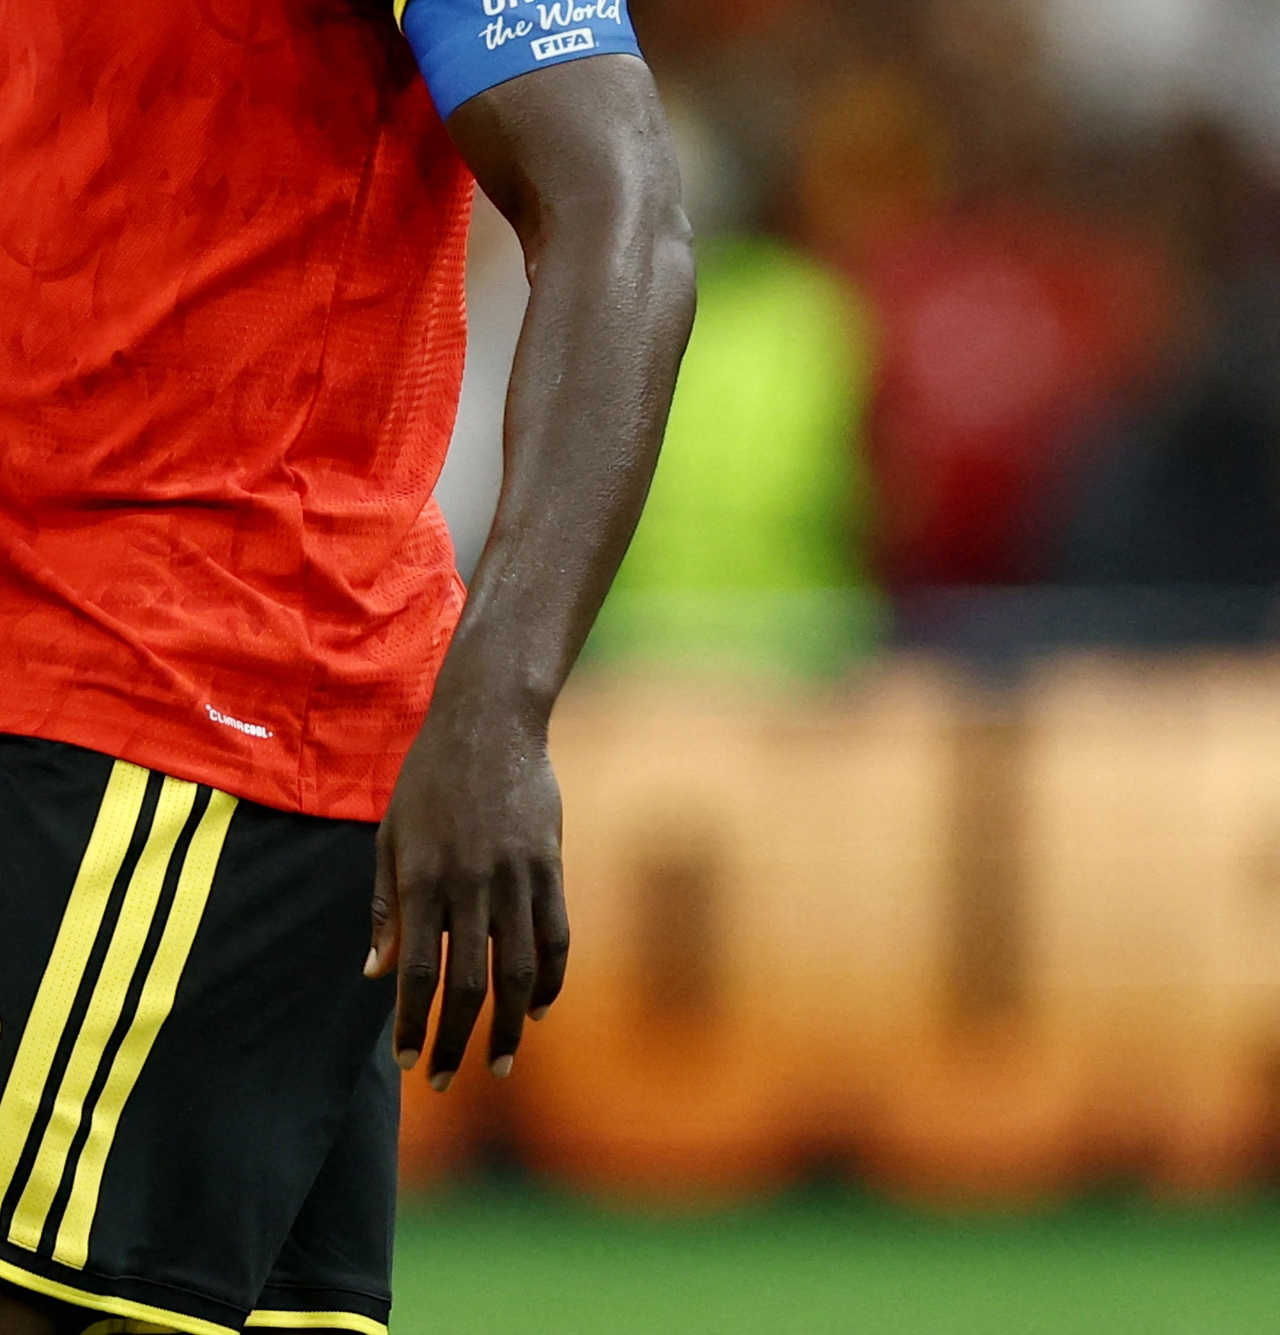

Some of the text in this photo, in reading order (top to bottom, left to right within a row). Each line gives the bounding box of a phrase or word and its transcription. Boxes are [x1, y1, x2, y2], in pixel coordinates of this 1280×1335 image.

[478, 16, 533, 50] the
[539, 33, 588, 54] FIFA
[209, 709, 268, 739] CLIMACOOL
